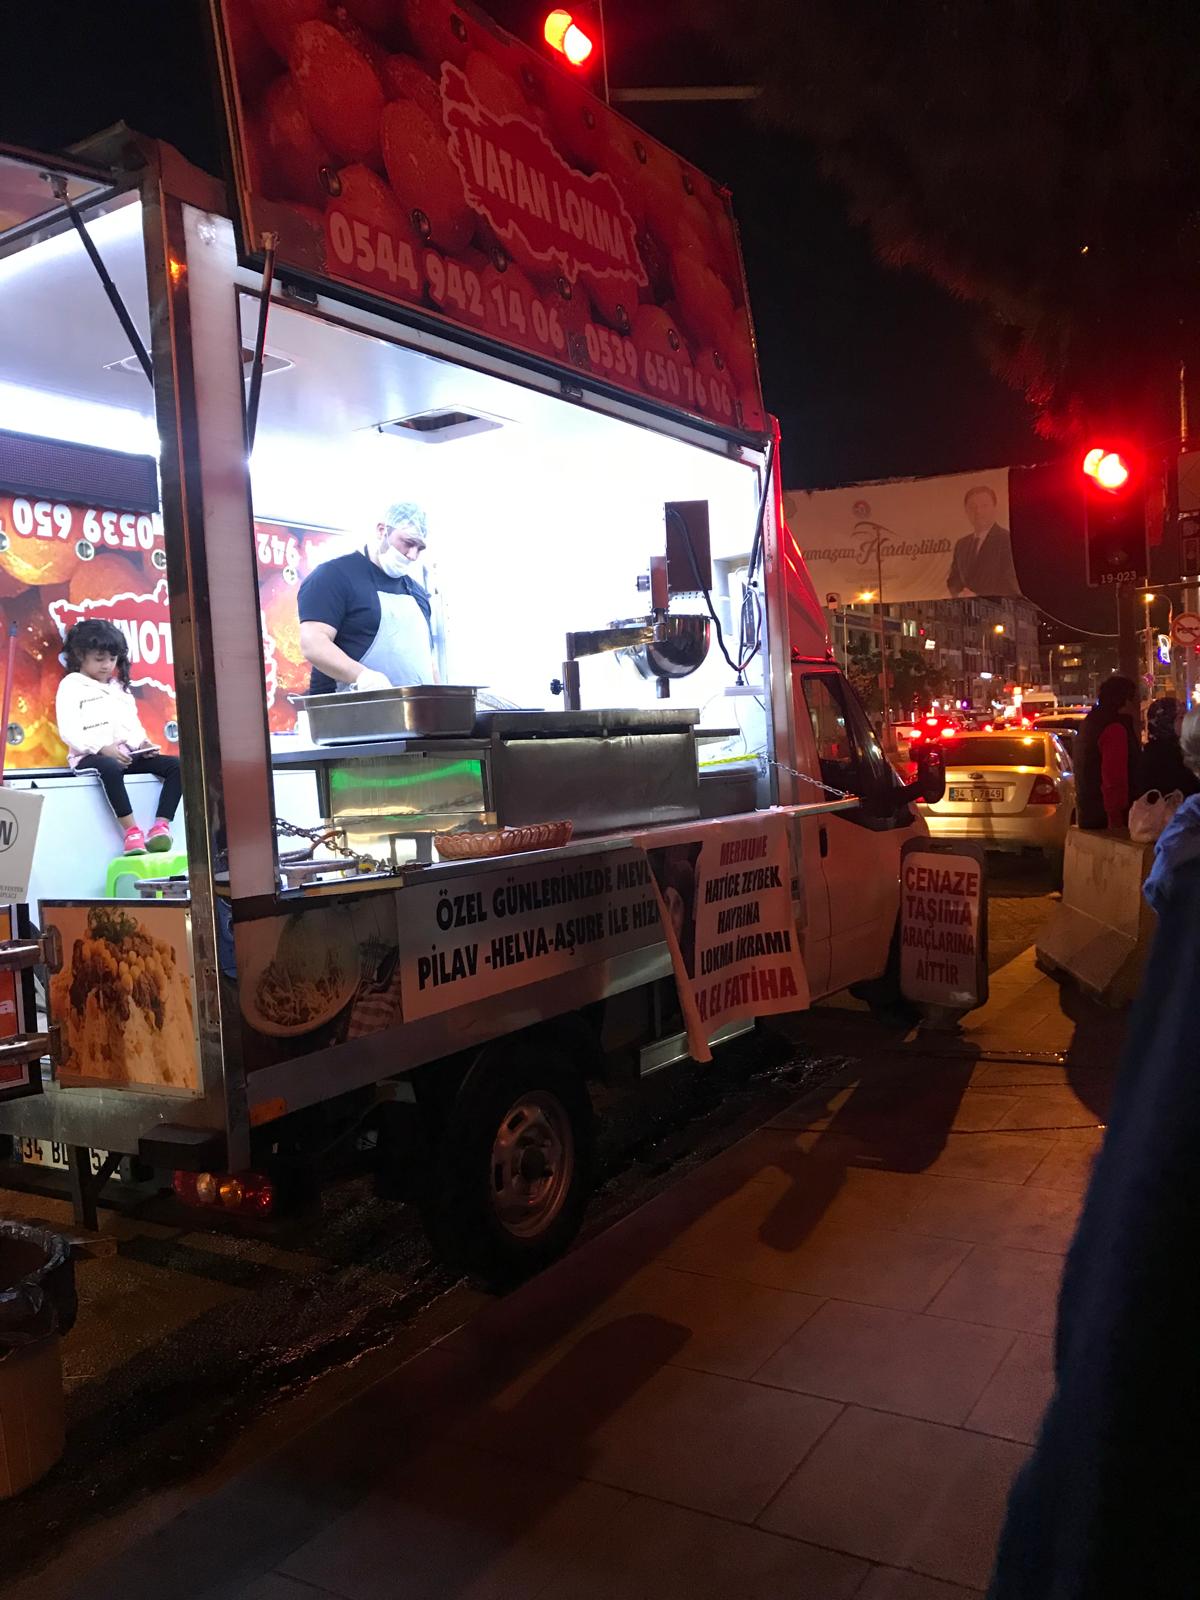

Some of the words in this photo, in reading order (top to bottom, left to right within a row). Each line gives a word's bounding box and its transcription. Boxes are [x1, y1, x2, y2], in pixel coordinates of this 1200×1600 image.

[464, 127, 552, 224] VATAN
[553, 180, 631, 265] LOKMA
[329, 211, 418, 290] 0544
[426, 252, 484, 317] 942
[490, 284, 526, 334] 14
[531, 299, 565, 349] 06
[584, 323, 638, 379] 0539
[645, 349, 680, 396] 650
[12, 498, 72, 539] 650
[83, 510, 154, 549] 0539
[803, 547, 856, 563] amazan
[1101, 571, 1138, 584] 19-023
[720, 835, 768, 867] MERHUME
[436, 888, 488, 931] ÖZEL
[493, 864, 613, 918] GÜNLERİNİZDE
[617, 858, 653, 890] MEVL
[705, 872, 741, 904] HATİCE
[741, 865, 782, 895] ZEYBEK
[905, 866, 978, 898] CENAZE
[717, 901, 761, 935] HAYRINA
[906, 895, 974, 929] TAŞIMA
[418, 943, 479, 991] PİLAV
[607, 902, 630, 937] İLE
[701, 941, 733, 976] LOKMA
[735, 930, 792, 962] İKRAMI
[902, 927, 976, 957] ARAÇLARINA
[724, 965, 798, 1009] FATİHA
[24, 1138, 44, 1161] 34
